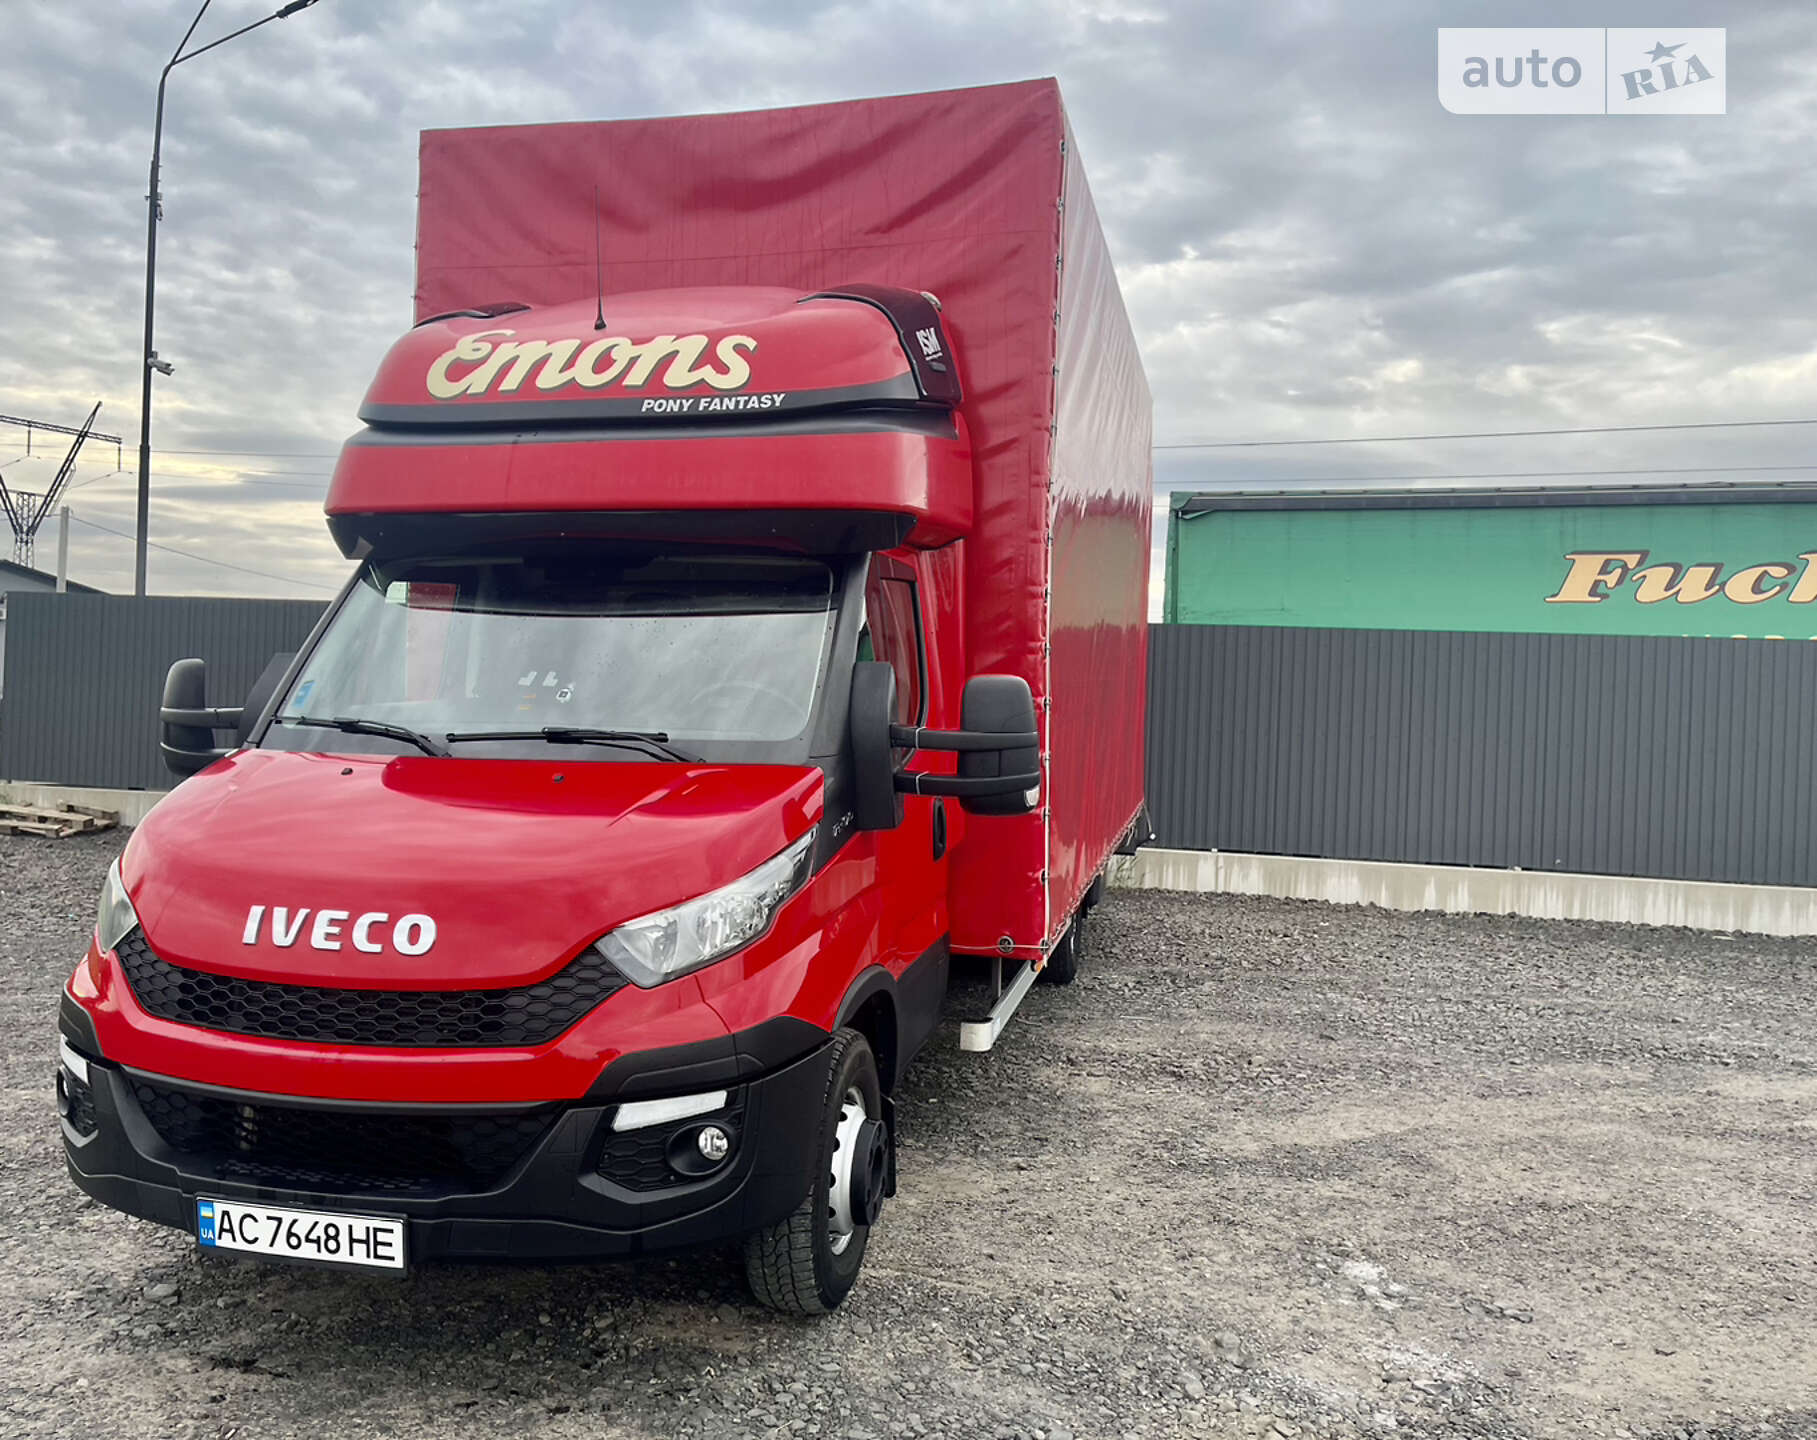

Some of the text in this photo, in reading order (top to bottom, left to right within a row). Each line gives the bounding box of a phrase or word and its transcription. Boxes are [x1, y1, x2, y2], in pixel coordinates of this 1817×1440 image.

[426, 329, 758, 400] Emons
[641, 393, 786, 413] PONY FANTASY
[242, 904, 438, 956] IVECO
[201, 1229, 214, 1240] UA
[217, 1210, 396, 1262] AC 7648 HE
